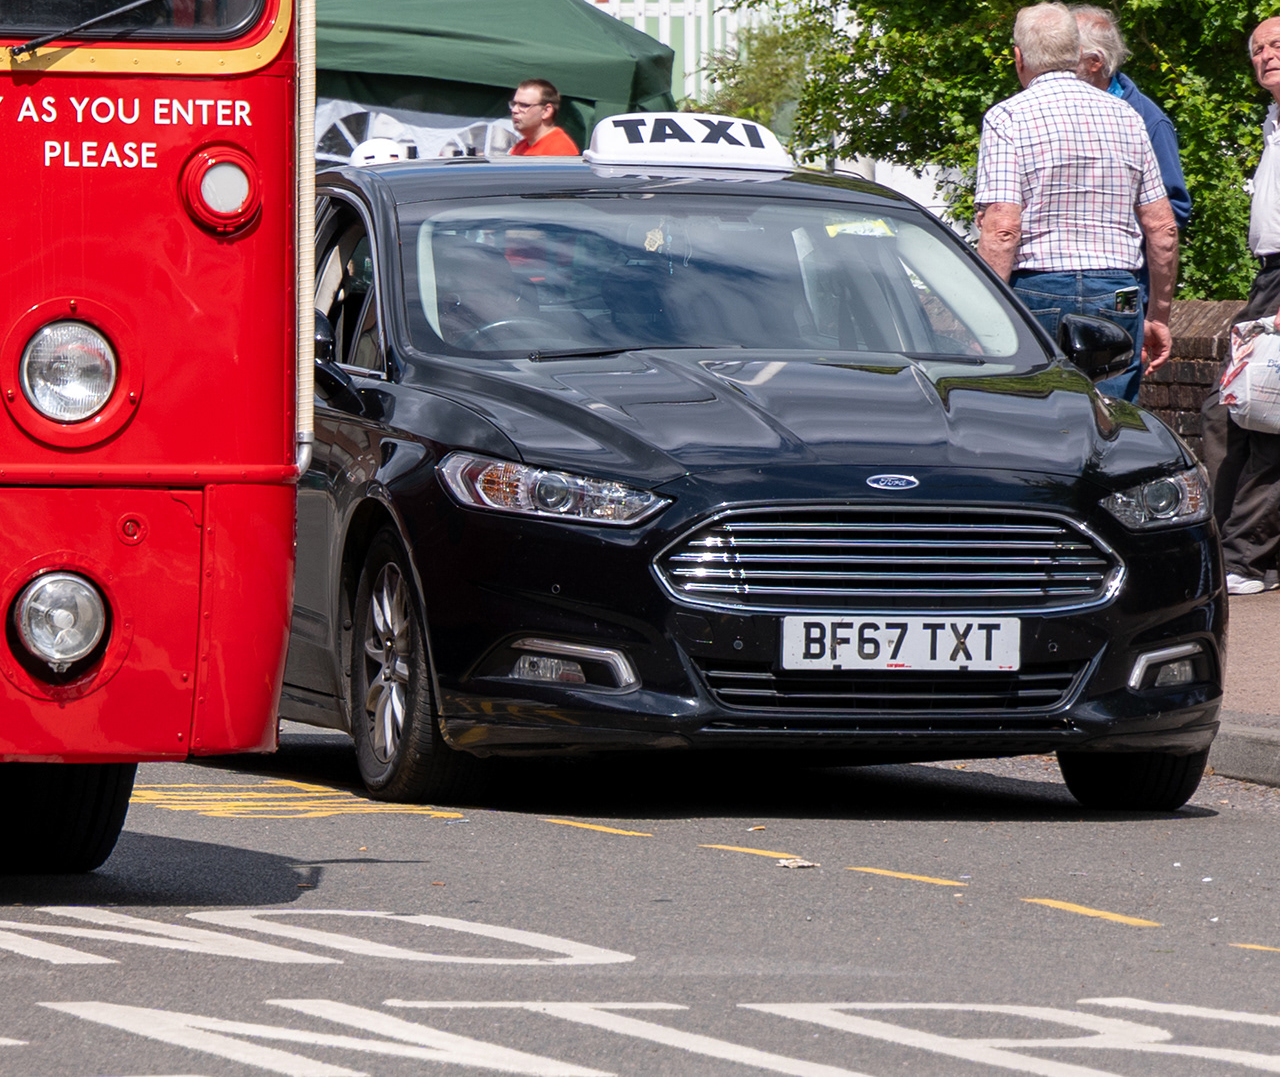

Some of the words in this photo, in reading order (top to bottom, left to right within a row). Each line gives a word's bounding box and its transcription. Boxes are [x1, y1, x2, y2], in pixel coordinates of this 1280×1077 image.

[17, 96, 57, 123] AS
[69, 96, 140, 124] YOU
[154, 98, 252, 126] ENTER
[612, 117, 765, 149] TAXI
[44, 140, 158, 168] PLEASE
[878, 477, 907, 487] Ford
[802, 621, 909, 661] BF67
[922, 622, 1001, 662] TXT
